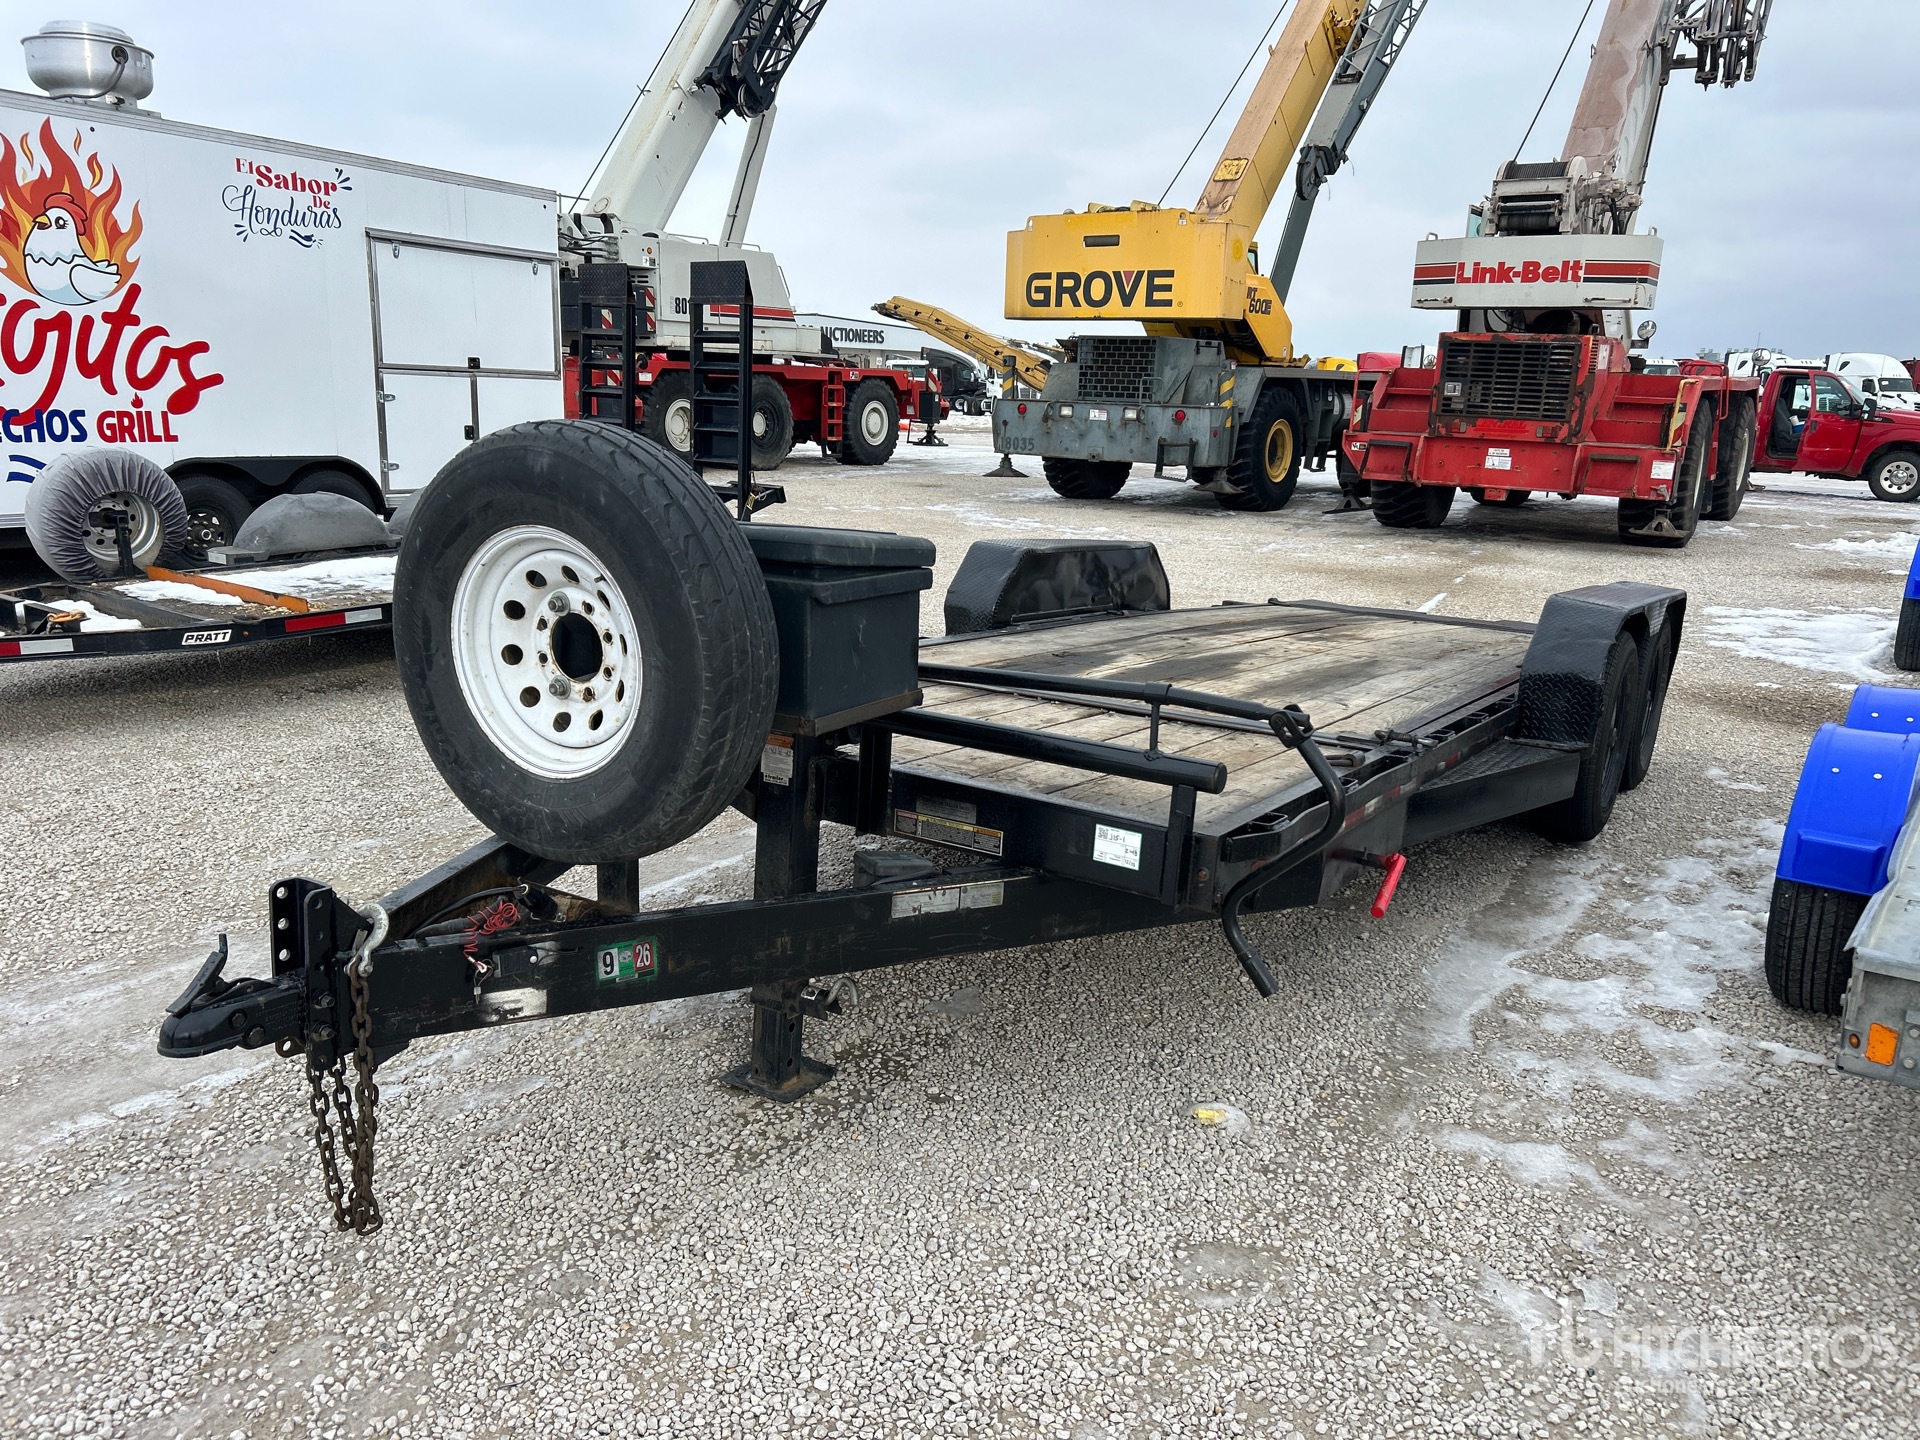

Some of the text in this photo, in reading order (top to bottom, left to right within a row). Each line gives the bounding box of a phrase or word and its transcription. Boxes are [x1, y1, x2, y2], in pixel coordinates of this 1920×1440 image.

[235, 157, 338, 196] El Sabor
[222, 184, 342, 237] Honduras
[312, 195, 331, 209] De
[1456, 259, 1583, 285] Link-Belt
[1025, 269, 1175, 308] GROVE
[1246, 286, 1258, 299] RT
[674, 296, 691, 315] 80
[1248, 297, 1273, 315] 600E
[0, 408, 179, 443] CHOS GRILL
[1000, 436, 1035, 452] 18035
[184, 631, 230, 643] PRATT
[602, 943, 651, 976] 9 26
